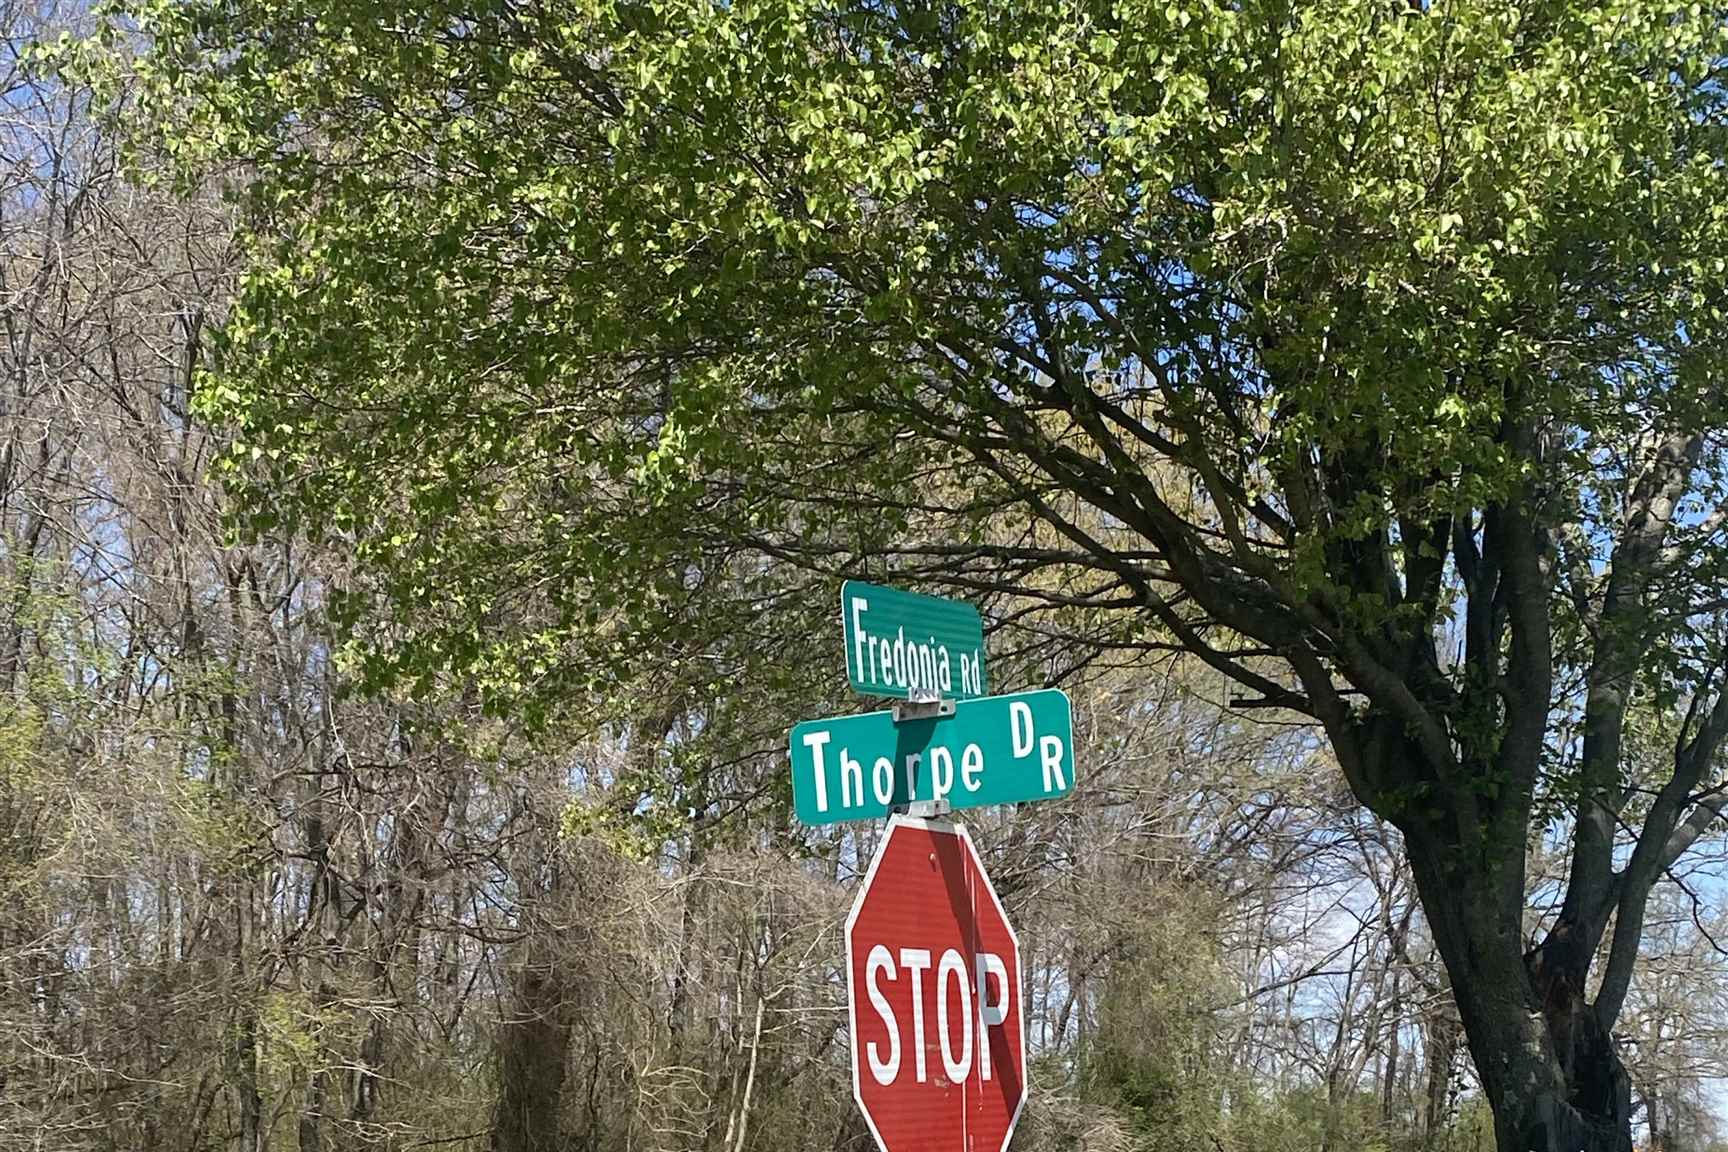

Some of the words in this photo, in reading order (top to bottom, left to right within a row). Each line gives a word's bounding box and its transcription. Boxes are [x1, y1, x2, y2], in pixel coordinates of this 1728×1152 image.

[852, 597, 951, 692] Fredonia
[961, 649, 981, 695] Rd
[803, 730, 984, 812] Thorpe
[865, 944, 1010, 1086] STOP
